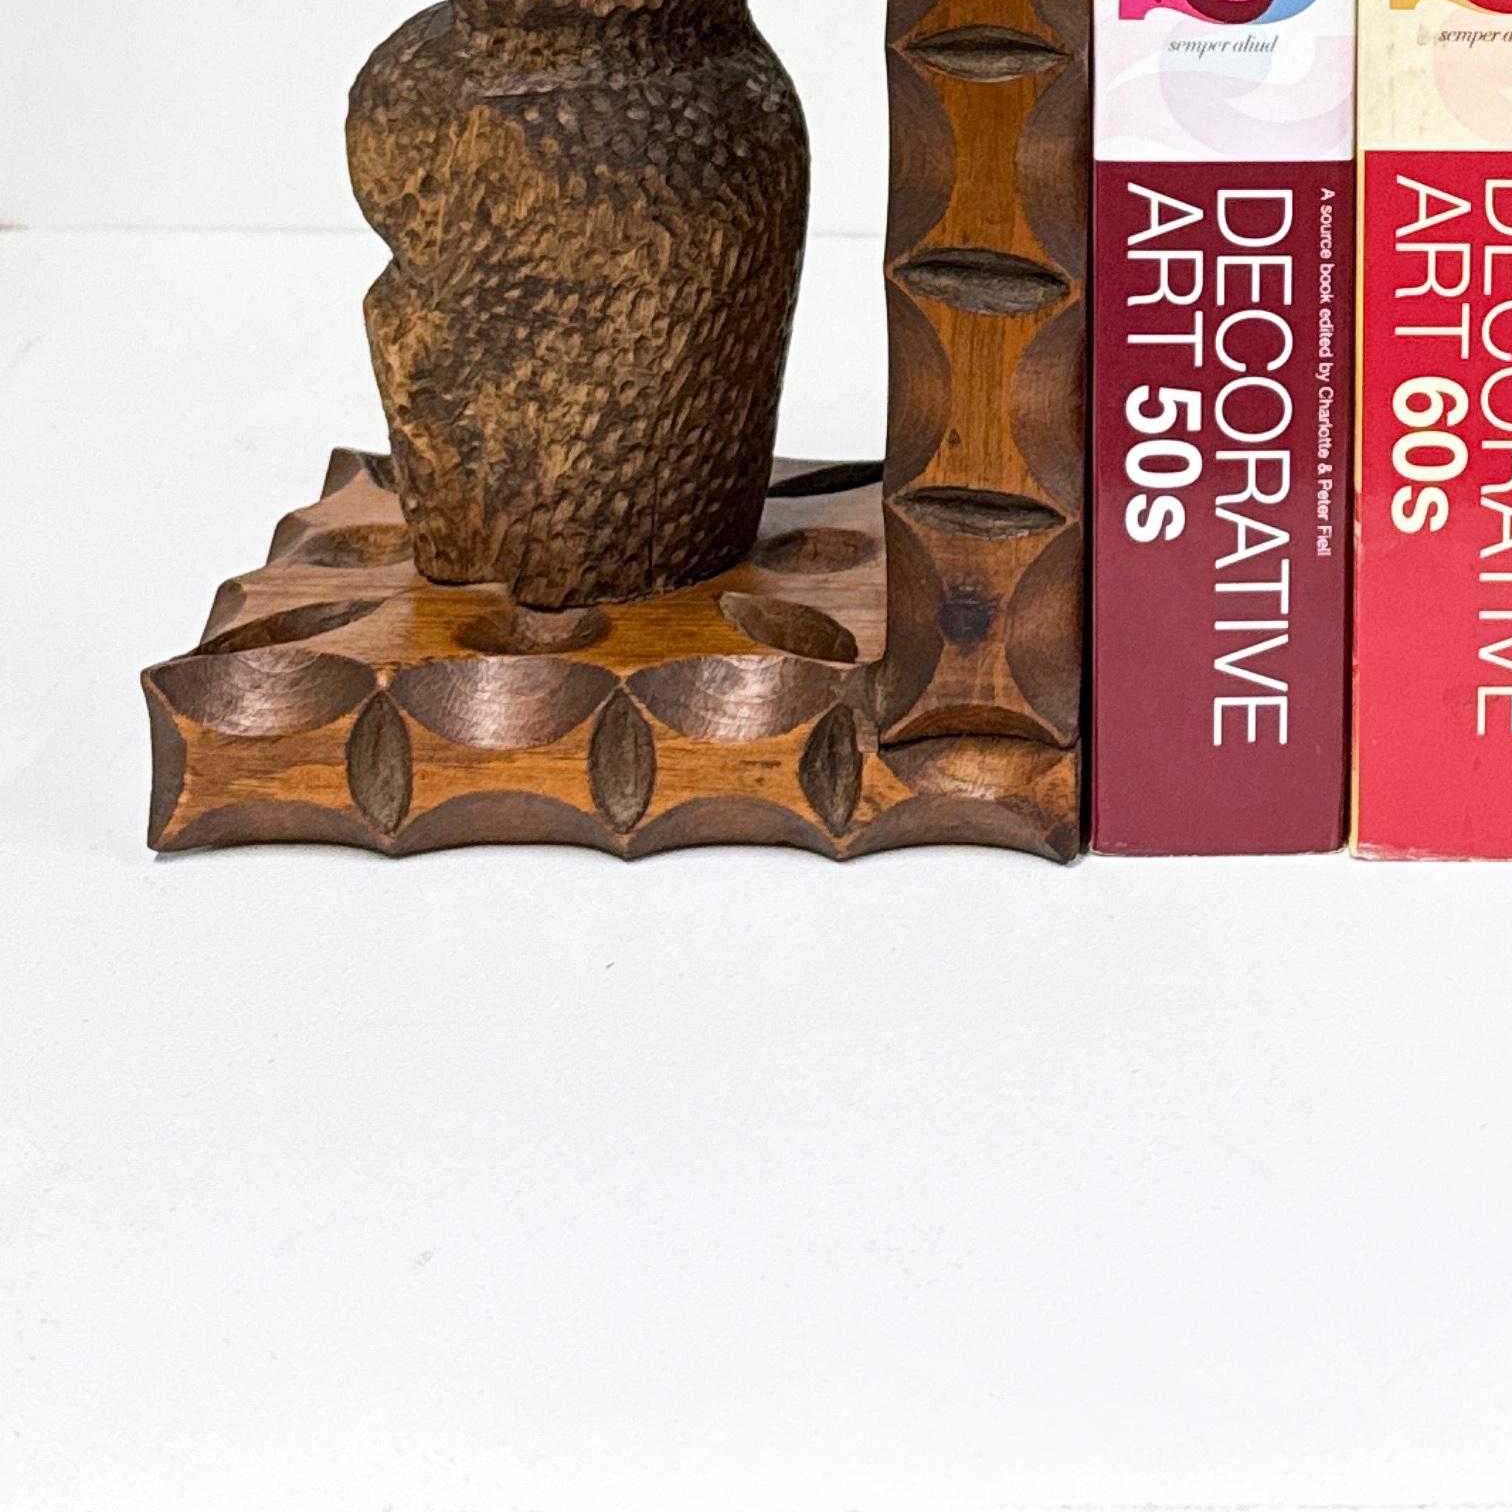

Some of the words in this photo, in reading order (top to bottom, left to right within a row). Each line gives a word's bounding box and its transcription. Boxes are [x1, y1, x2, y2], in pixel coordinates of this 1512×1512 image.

[1168, 40, 1231, 59] semper
[1232, 34, 1279, 53] aliud
[1439, 30, 1501, 48] semper
[1321, 189, 1335, 200] A
[1320, 205, 1332, 258] source
[1128, 183, 1203, 367] ART
[1320, 264, 1334, 303] book
[1395, 175, 1471, 359] ART
[1319, 309, 1333, 357] edited
[1316, 363, 1333, 381] by
[1318, 387, 1333, 458] Charlotte
[1125, 386, 1202, 542] 50s
[1214, 190, 1292, 746] DECORATIVE
[1318, 463, 1332, 474] &
[1391, 377, 1468, 533] 60s
[1318, 480, 1332, 520] Peter
[1317, 526, 1332, 555] Fiell
